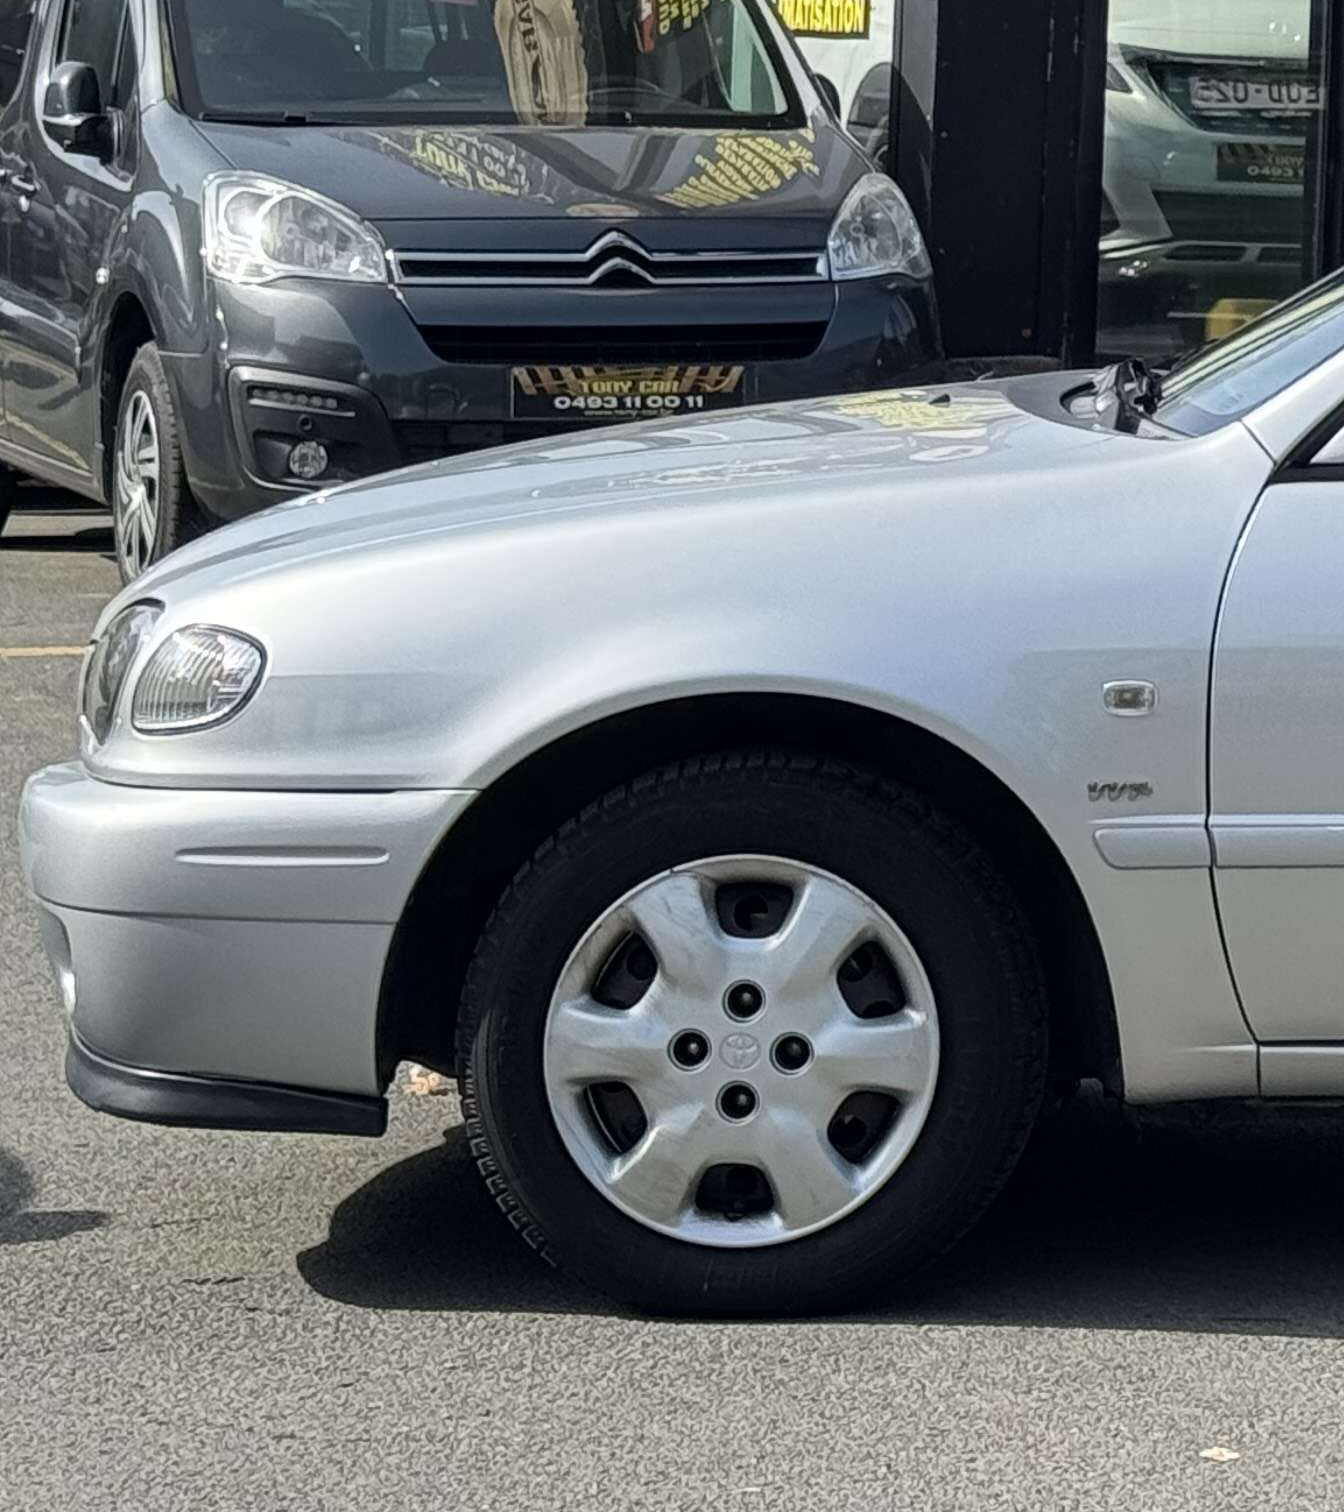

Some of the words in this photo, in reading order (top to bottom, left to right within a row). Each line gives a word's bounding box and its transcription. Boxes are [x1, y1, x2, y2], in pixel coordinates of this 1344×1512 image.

[580, 381, 632, 394] TONY
[640, 380, 680, 394] CAR
[553, 395, 619, 409] 0493
[623, 395, 641, 409] 11
[646, 395, 681, 409] 00
[686, 394, 704, 408] 11
